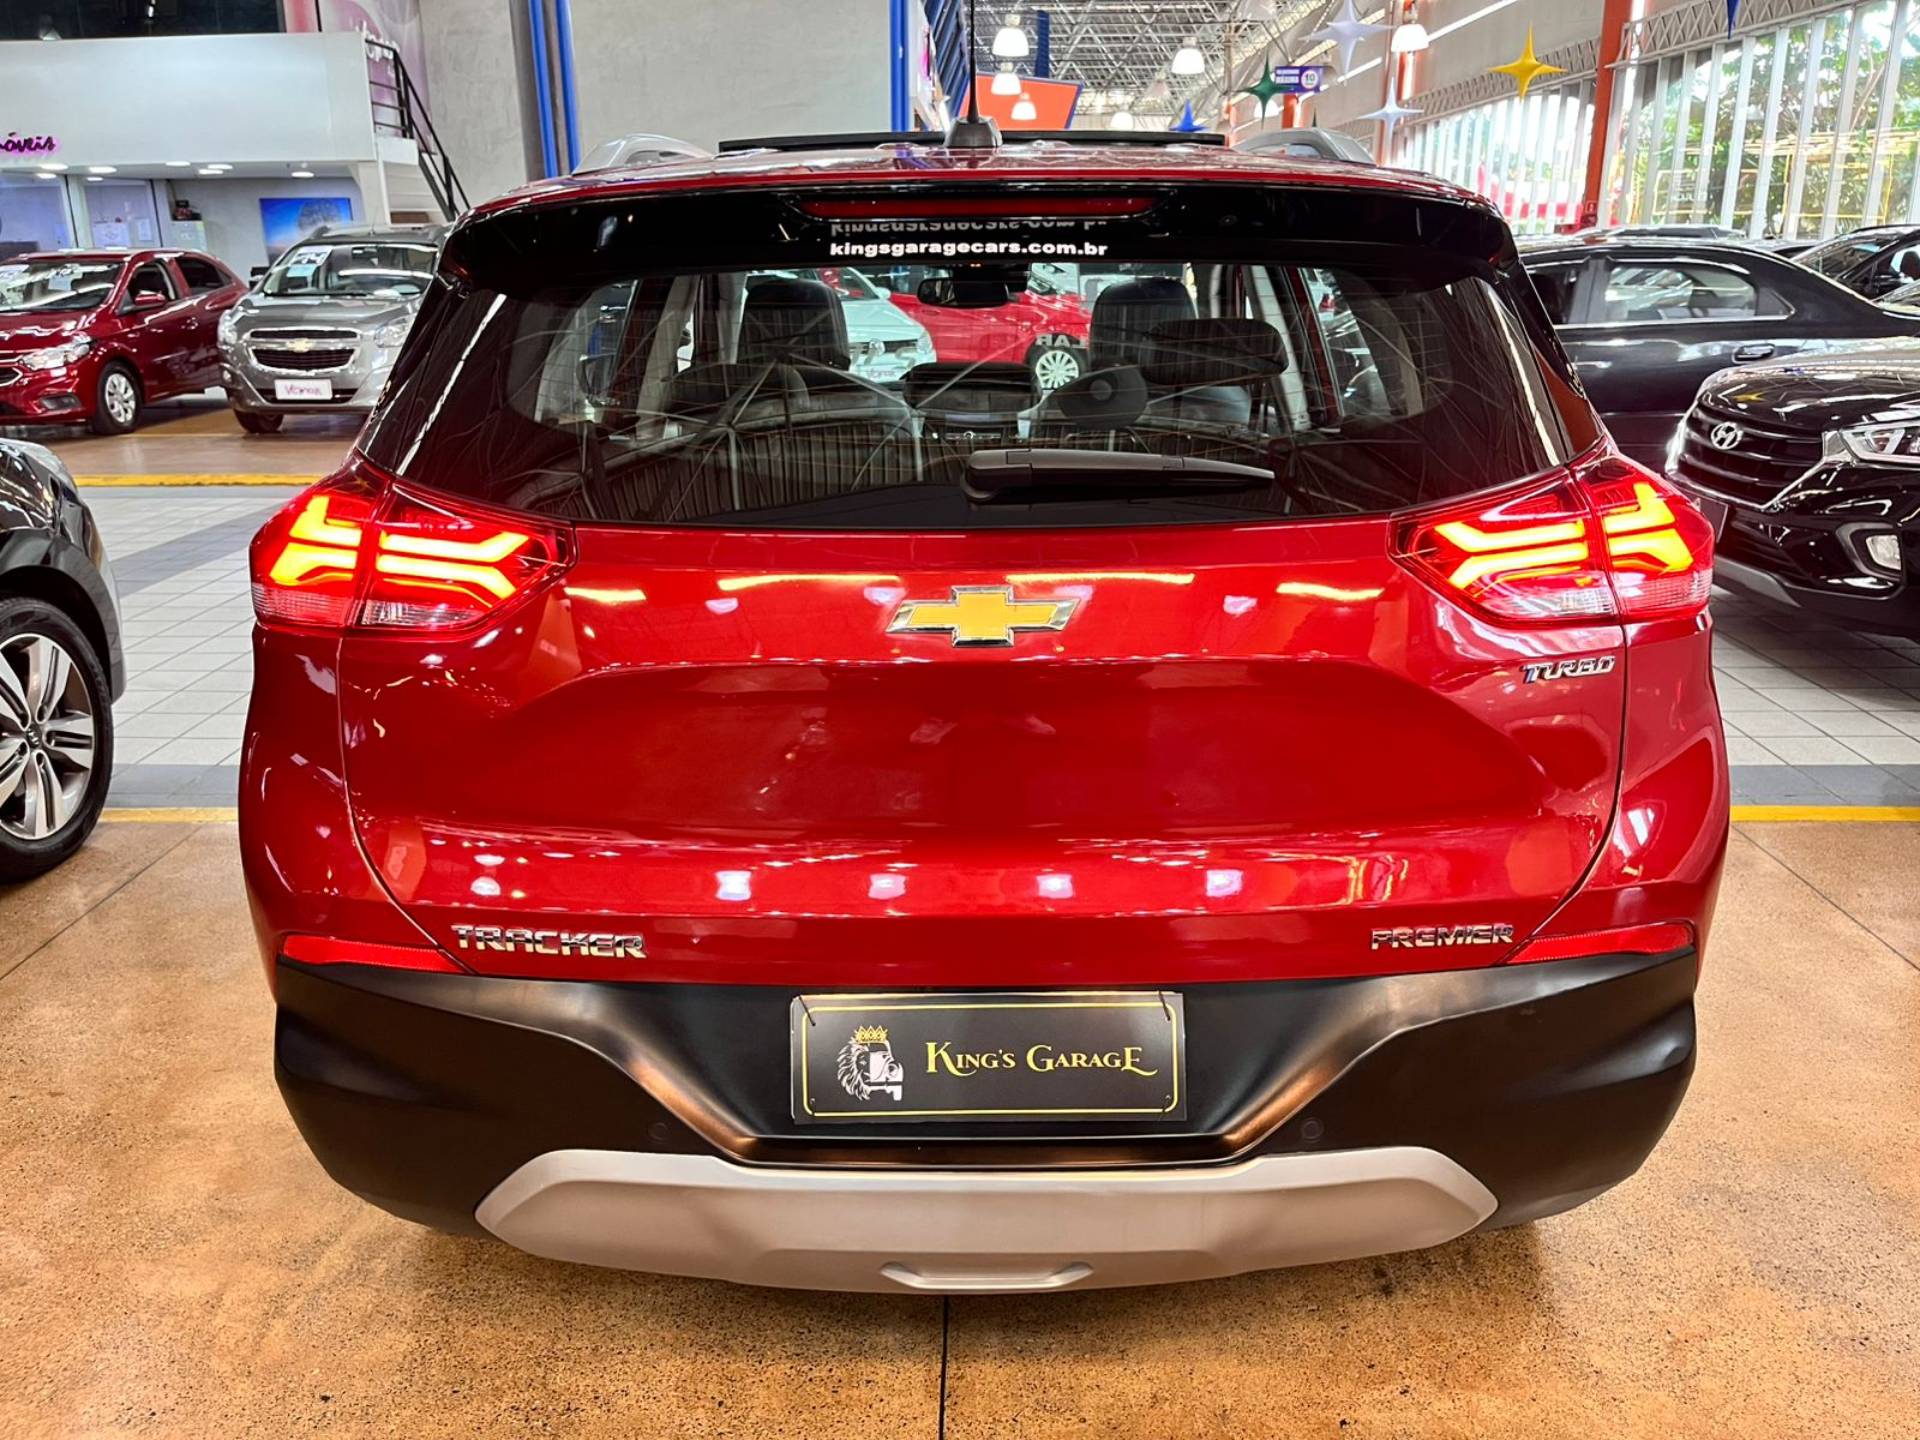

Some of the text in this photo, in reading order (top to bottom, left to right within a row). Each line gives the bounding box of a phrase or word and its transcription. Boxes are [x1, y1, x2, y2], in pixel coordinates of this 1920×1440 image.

[0, 131, 56, 152] óveis
[829, 242, 1108, 258] kingsgaragecars.com.br
[1522, 656, 1615, 684] TURBO
[451, 924, 647, 959] TRACKER
[1371, 923, 1514, 950] PREMIER
[1026, 1044, 1158, 1077] GARAGE
